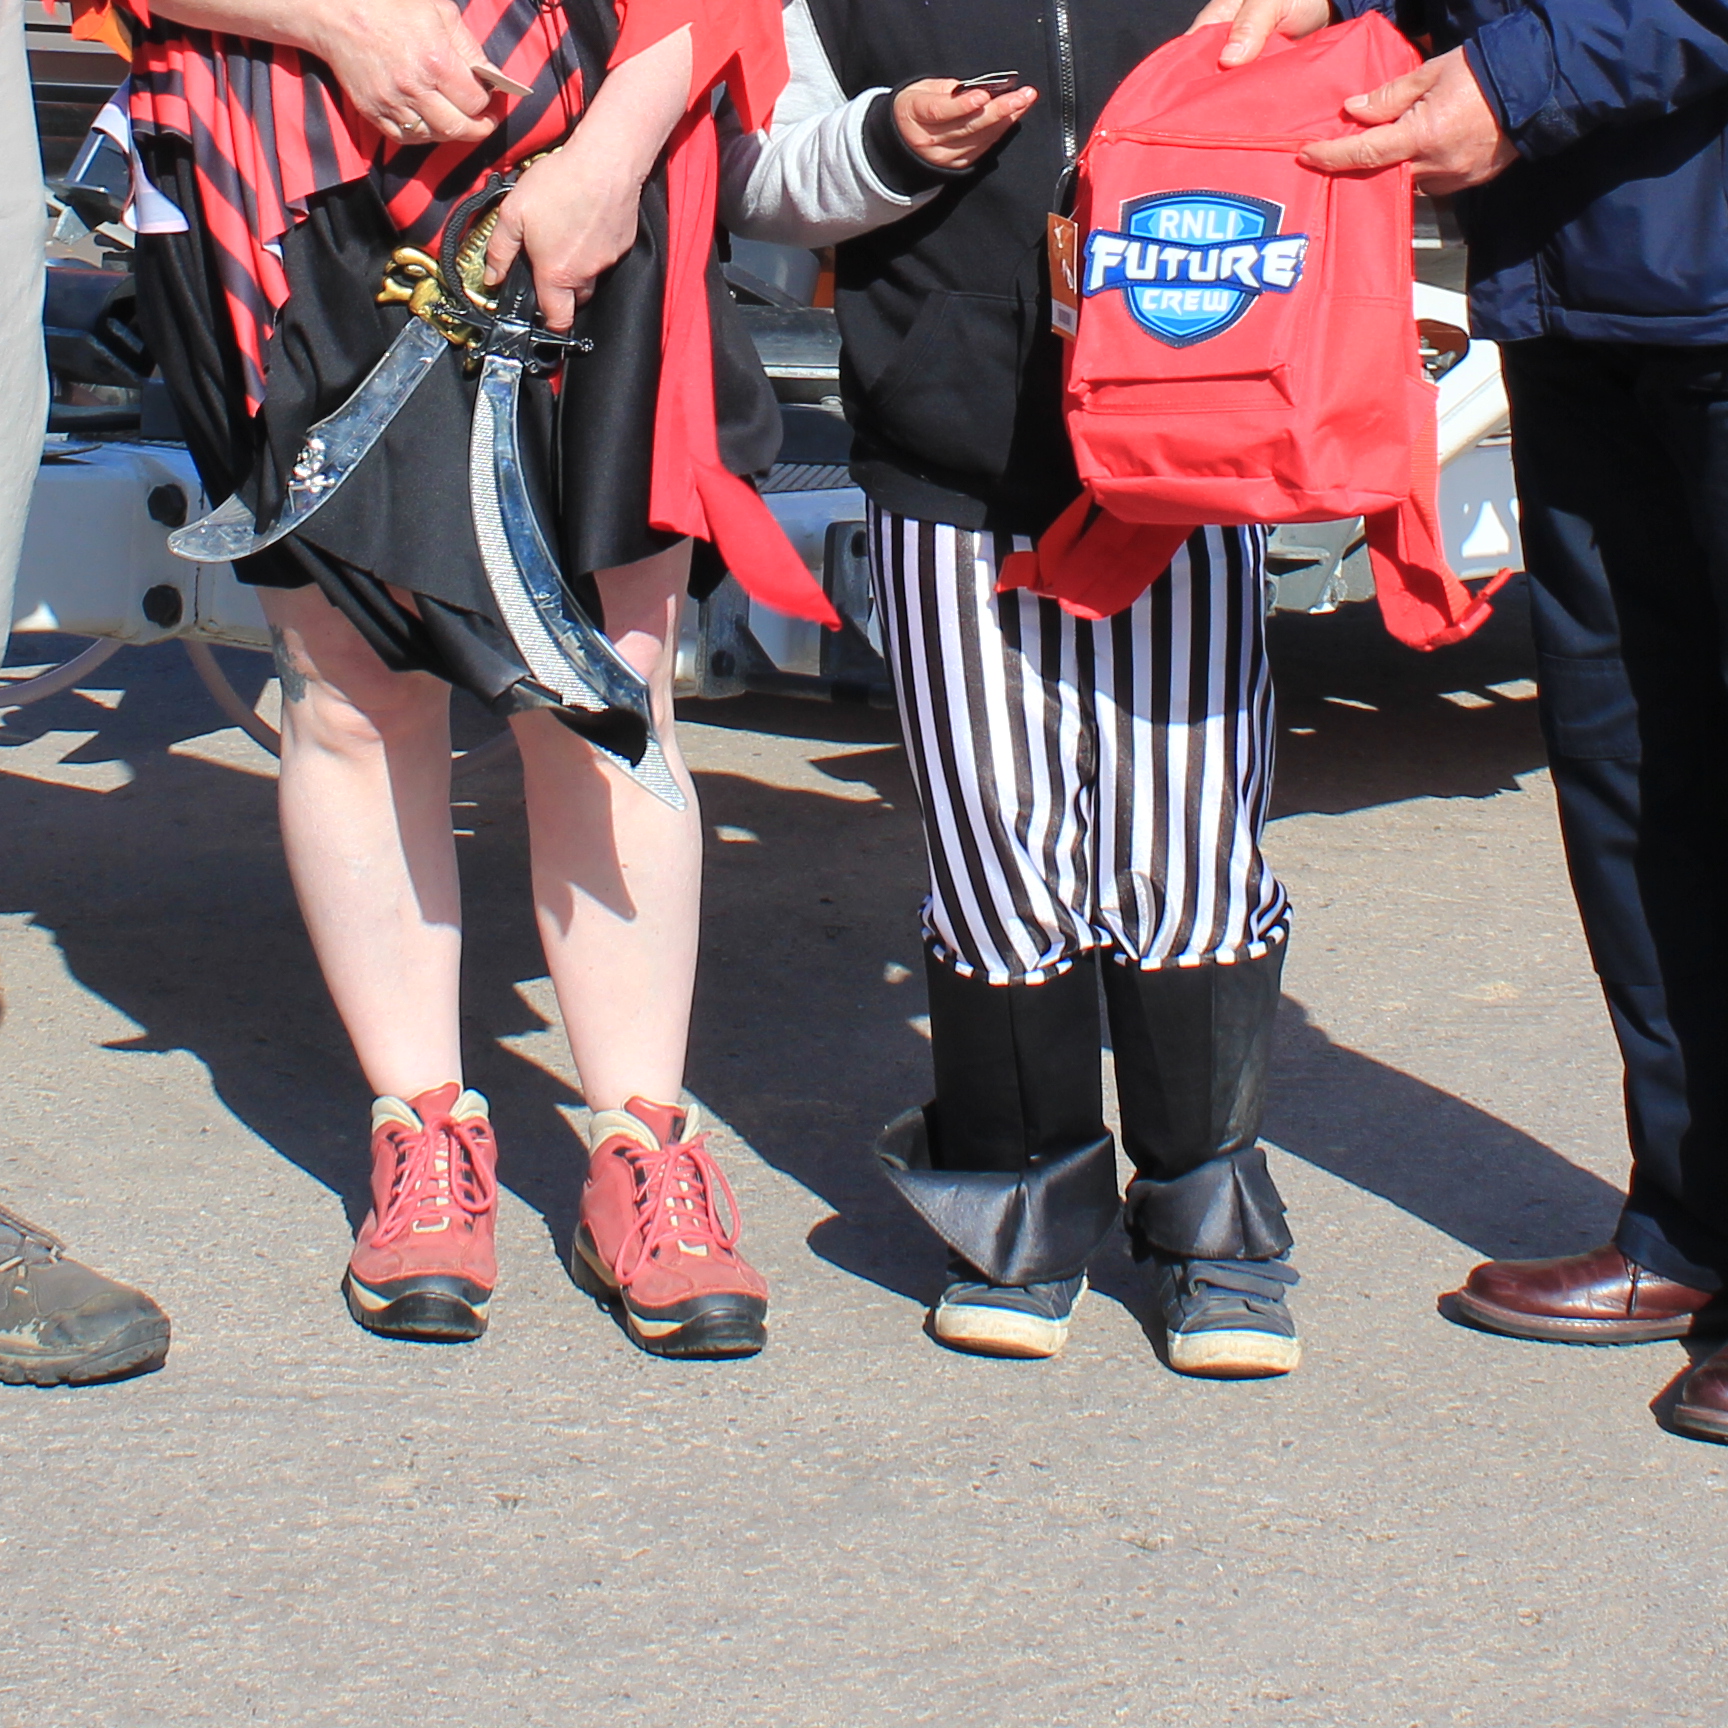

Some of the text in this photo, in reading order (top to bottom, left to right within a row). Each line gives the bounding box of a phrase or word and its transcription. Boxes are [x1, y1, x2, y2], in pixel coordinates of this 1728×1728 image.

[1158, 208, 1236, 240] RNLI
[1090, 234, 1303, 292] FUTURE
[1141, 288, 1230, 316] CREW
